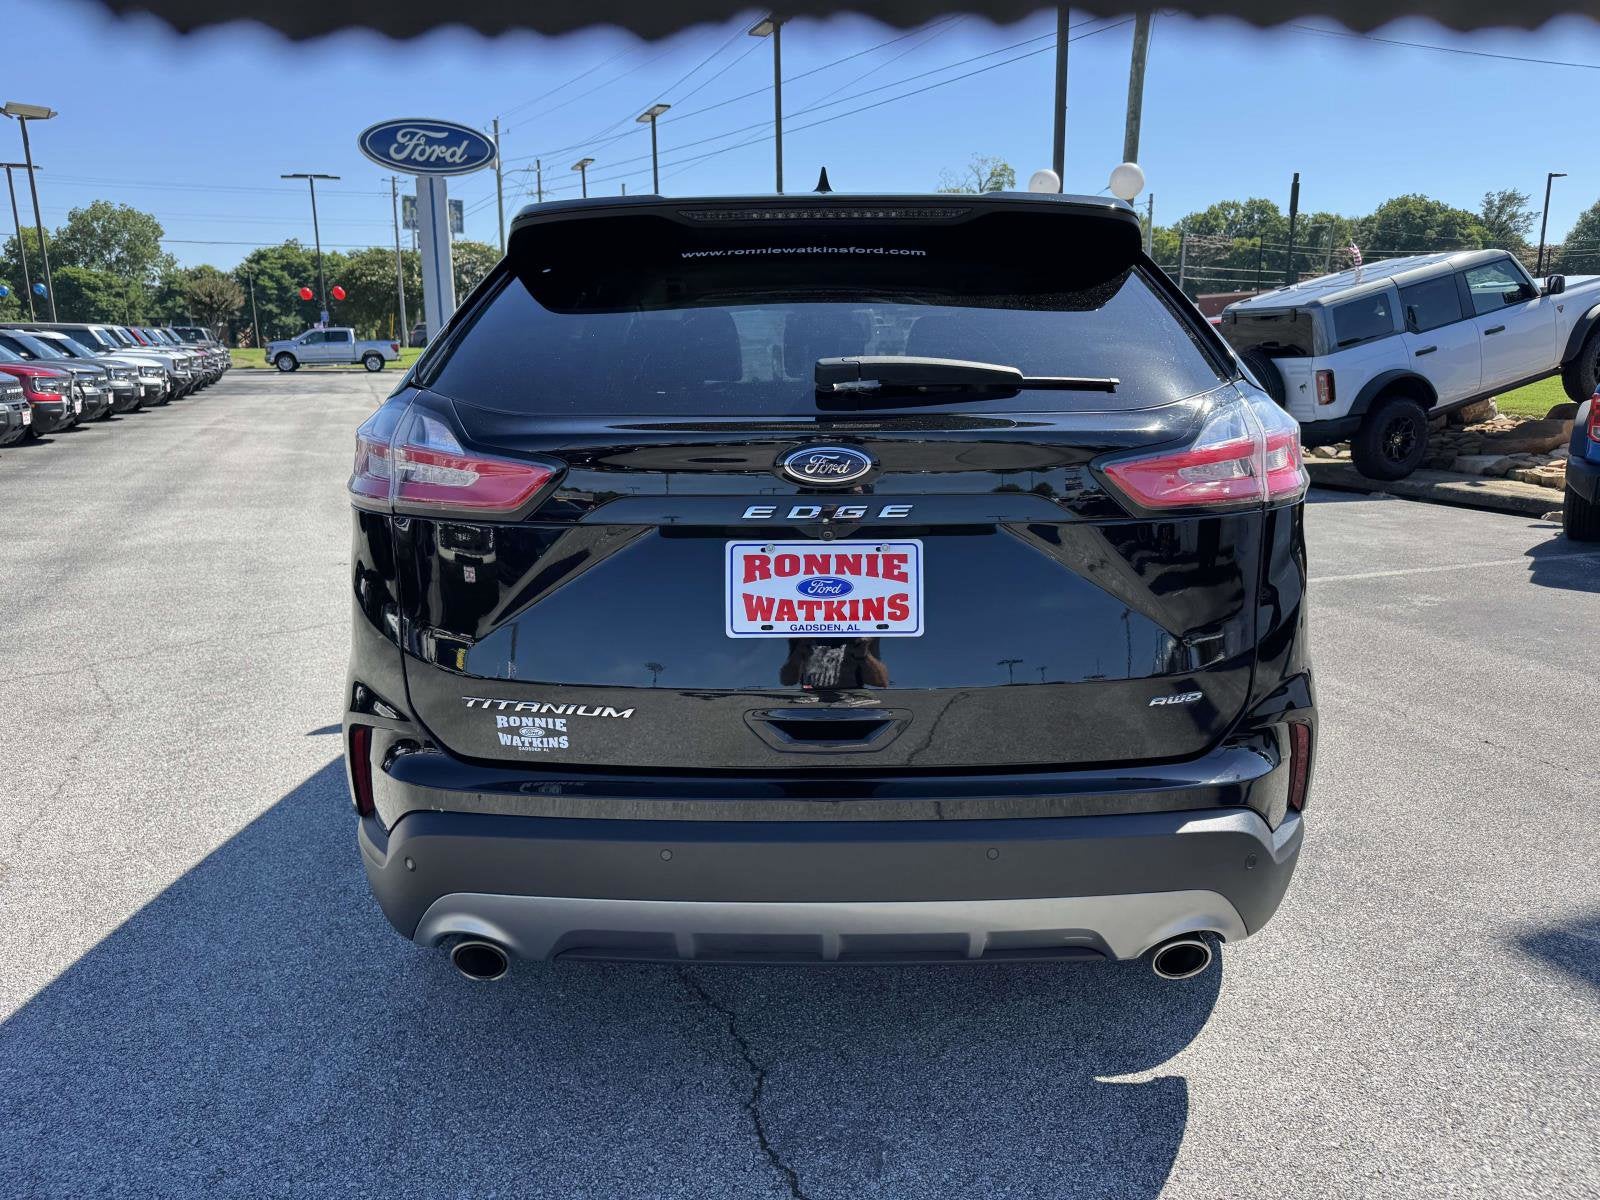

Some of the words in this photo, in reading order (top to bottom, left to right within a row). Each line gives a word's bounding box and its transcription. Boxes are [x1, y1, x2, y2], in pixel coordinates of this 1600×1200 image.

[389, 128, 469, 163] Ford
[681, 246, 927, 258] www.ronniewatkinsford.com
[804, 454, 850, 475] Ford
[742, 504, 914, 519] EDGE
[742, 553, 909, 584] RONNIE
[807, 579, 842, 595] Ford
[742, 593, 910, 622] WATKINS
[790, 624, 844, 632] GADSDEN,
[1148, 691, 1203, 707] AWD
[462, 696, 636, 719] TITANIUM
[496, 715, 567, 732] RONNIE
[497, 732, 569, 748] WATKINS
